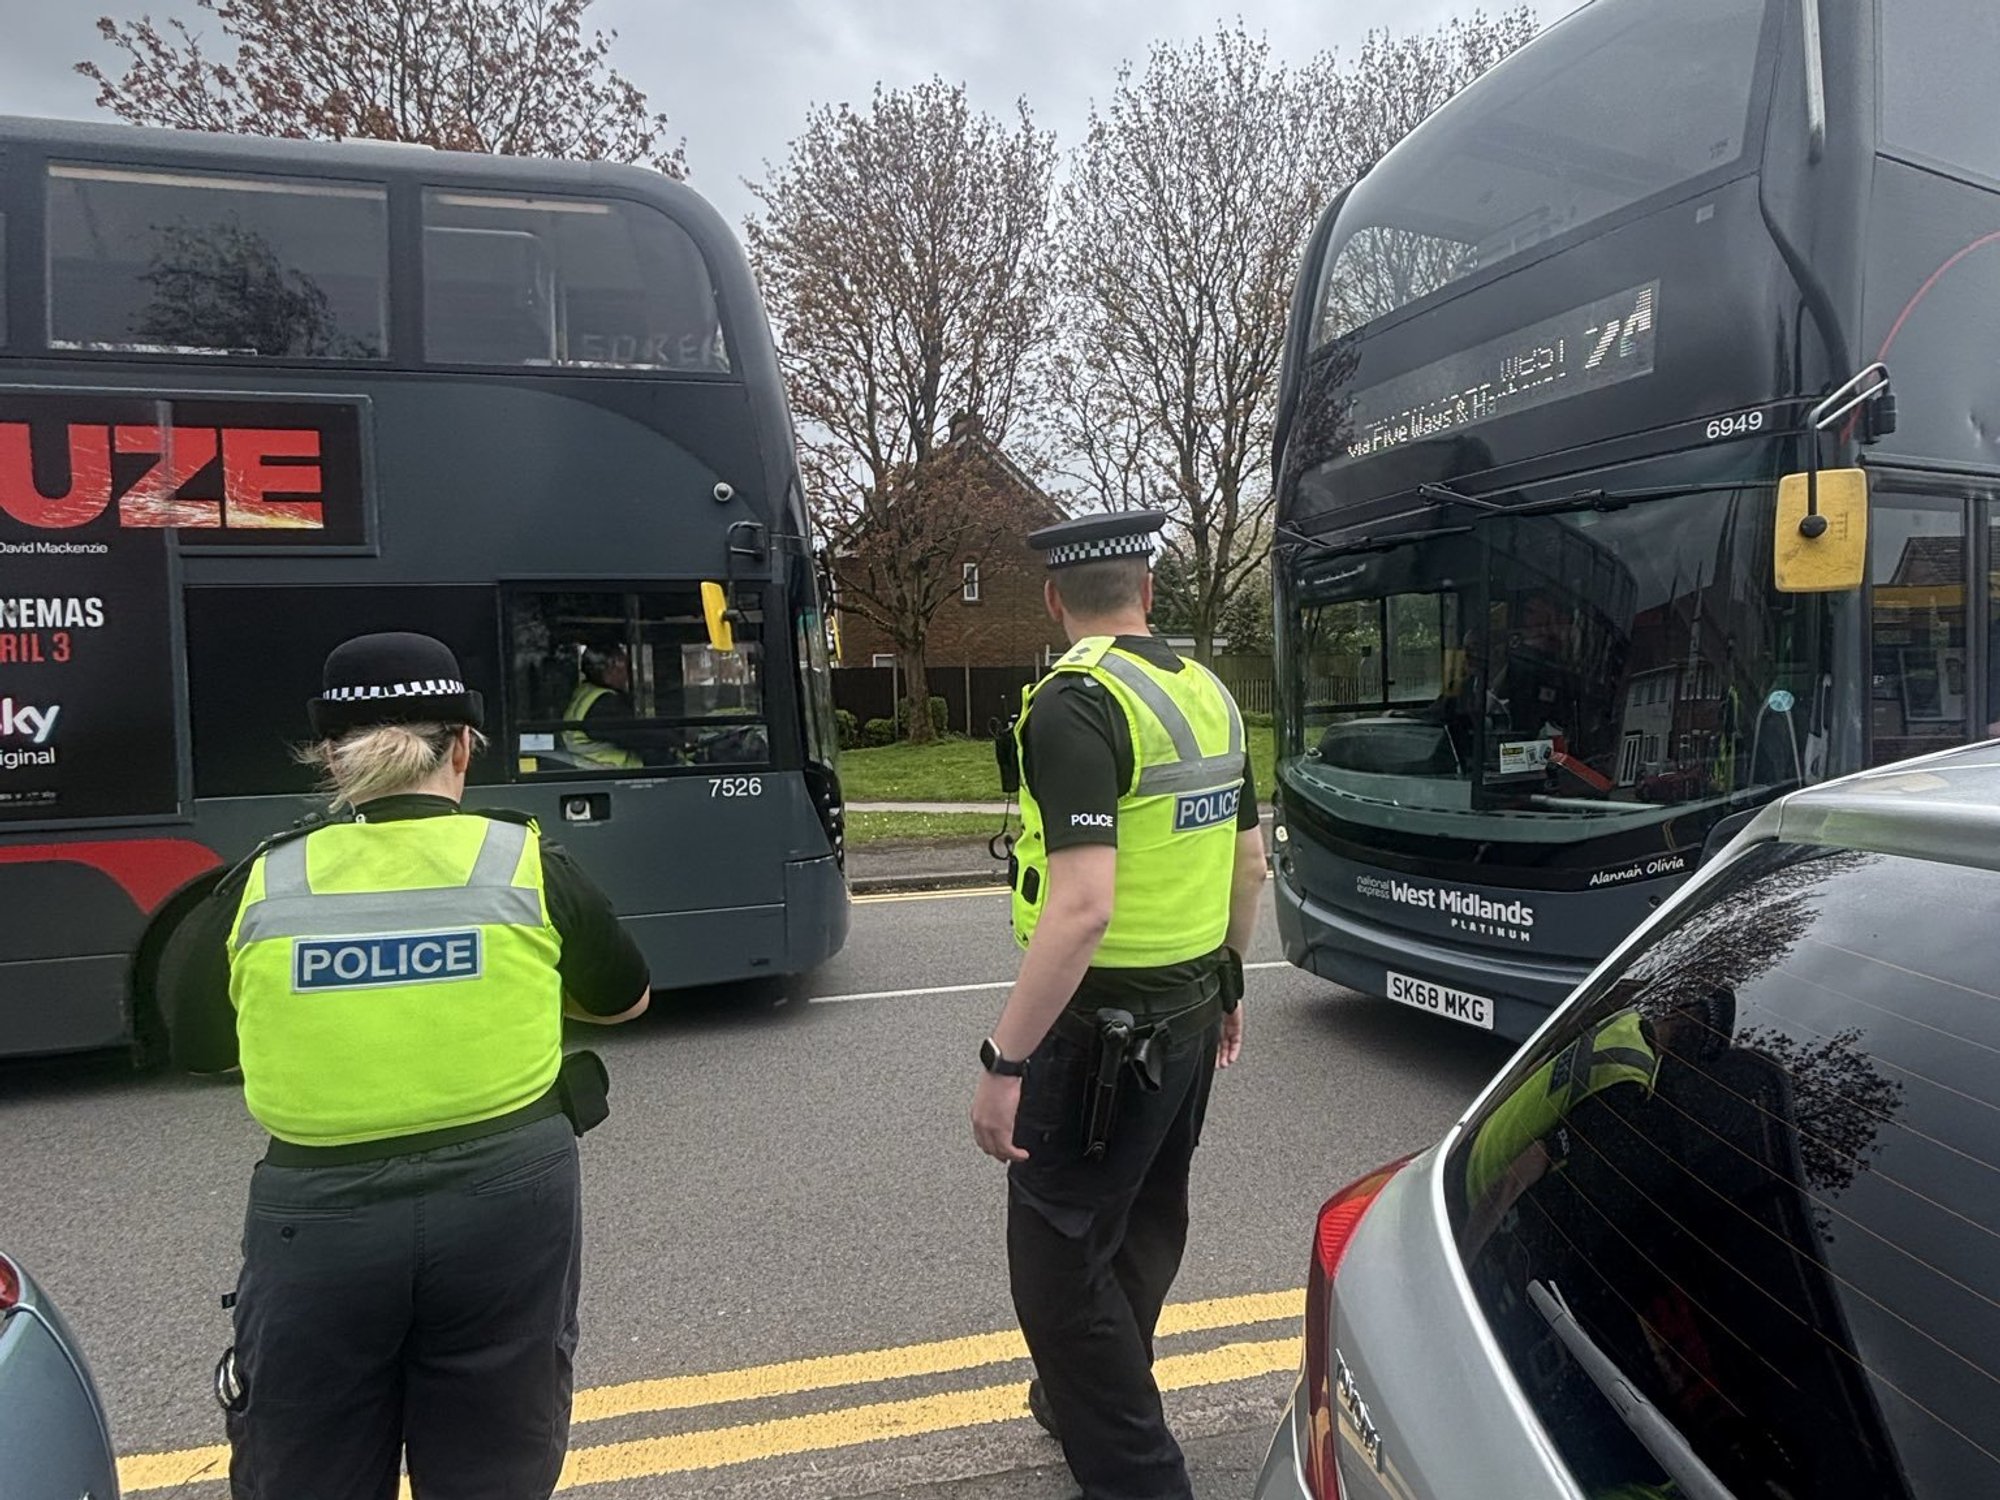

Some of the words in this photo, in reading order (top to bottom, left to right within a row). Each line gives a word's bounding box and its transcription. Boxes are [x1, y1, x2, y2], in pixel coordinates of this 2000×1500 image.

[1373, 424, 1408, 451] Five
[1706, 411, 1763, 439] 6949
[0, 542, 34, 554] David
[36, 542, 108, 554] Mackenzie
[52, 631, 71, 662] 3
[708, 777, 762, 798] 7526
[1070, 813, 1114, 827] POLICE
[1179, 789, 1240, 826] POLICE
[1646, 856, 1685, 874] Olivia
[1356, 874, 1391, 890] national
[1356, 885, 1391, 900] express
[1390, 879, 1436, 909] West
[1439, 888, 1534, 927] Midlands
[1451, 918, 1531, 942] PLATINUM
[302, 939, 473, 982] POLICE
[1392, 976, 1439, 1009] SK68
[1444, 991, 1485, 1023] MKG
